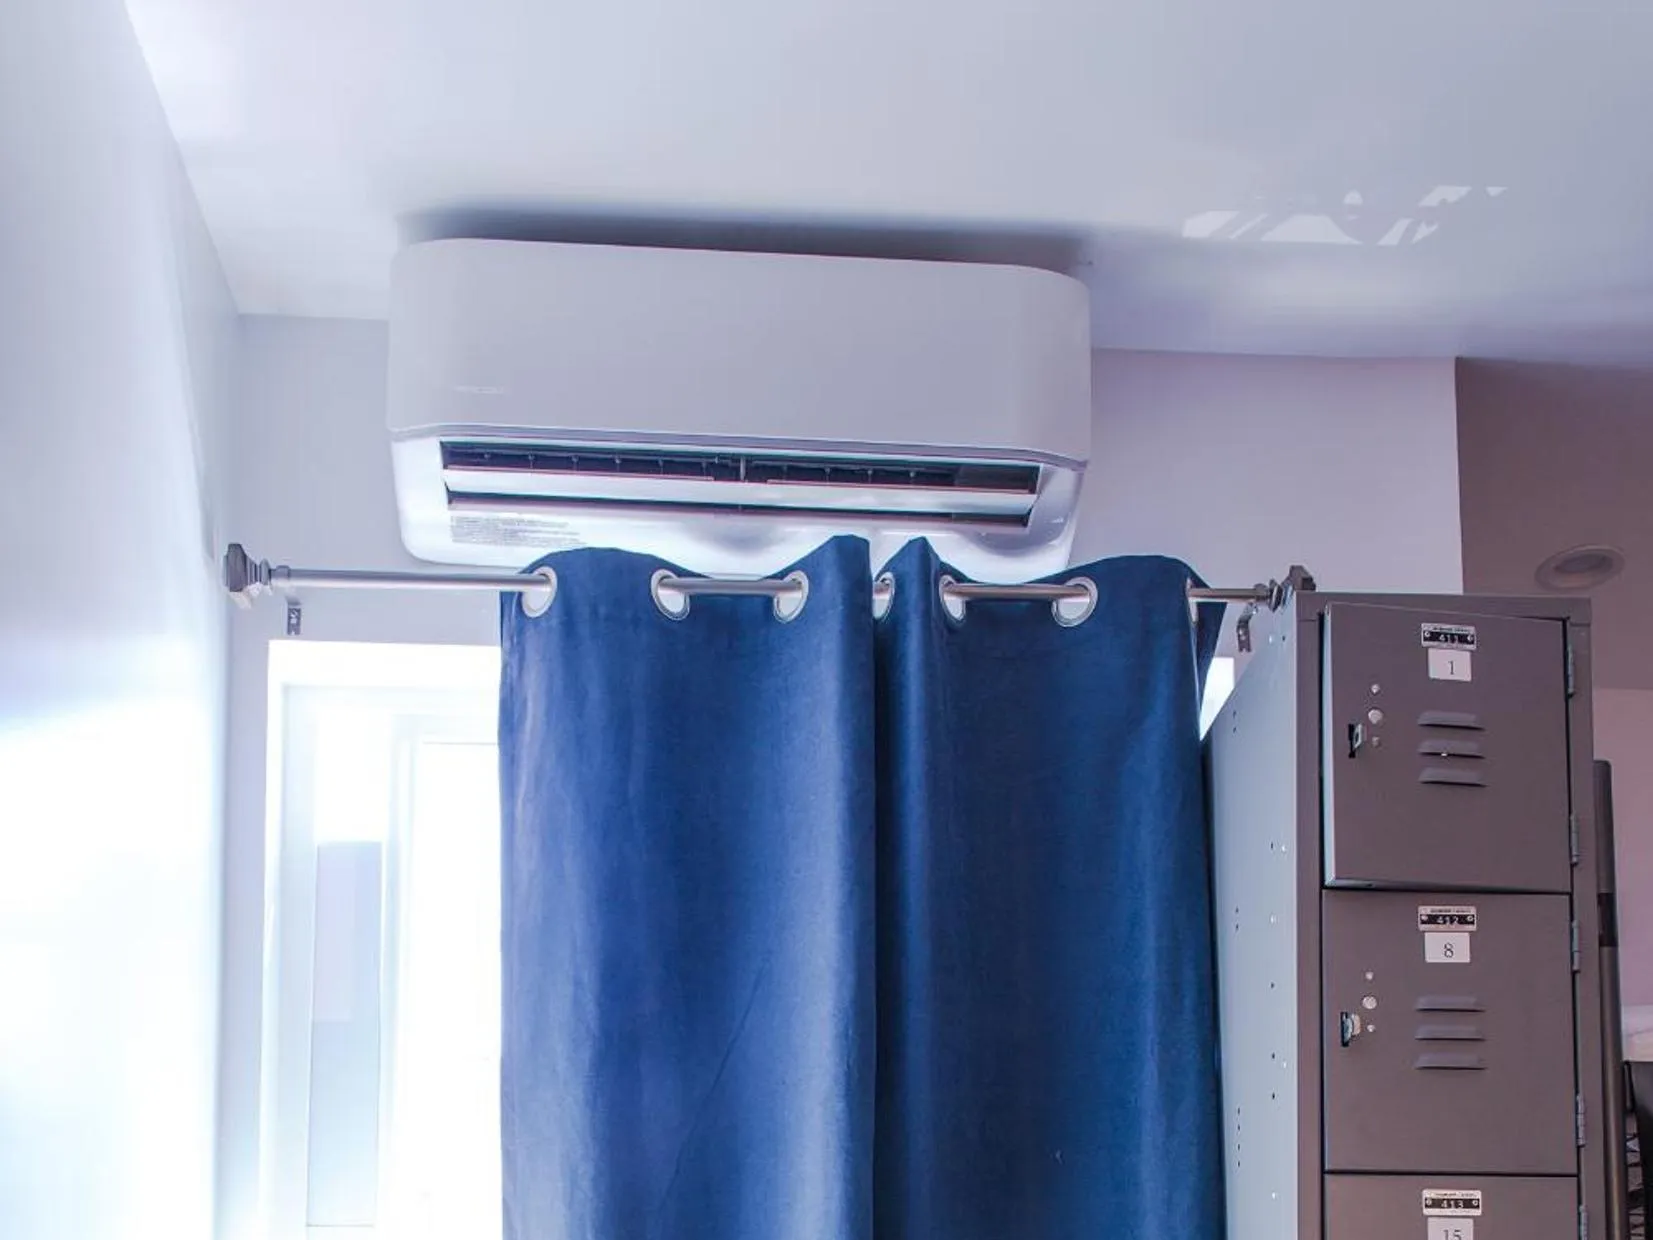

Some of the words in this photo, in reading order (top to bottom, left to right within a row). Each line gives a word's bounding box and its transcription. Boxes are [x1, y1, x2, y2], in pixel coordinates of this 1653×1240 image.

[1448, 660, 1455, 675] 1
[1444, 942, 1454, 958] 8
[1441, 1200, 1464, 1209] 413
